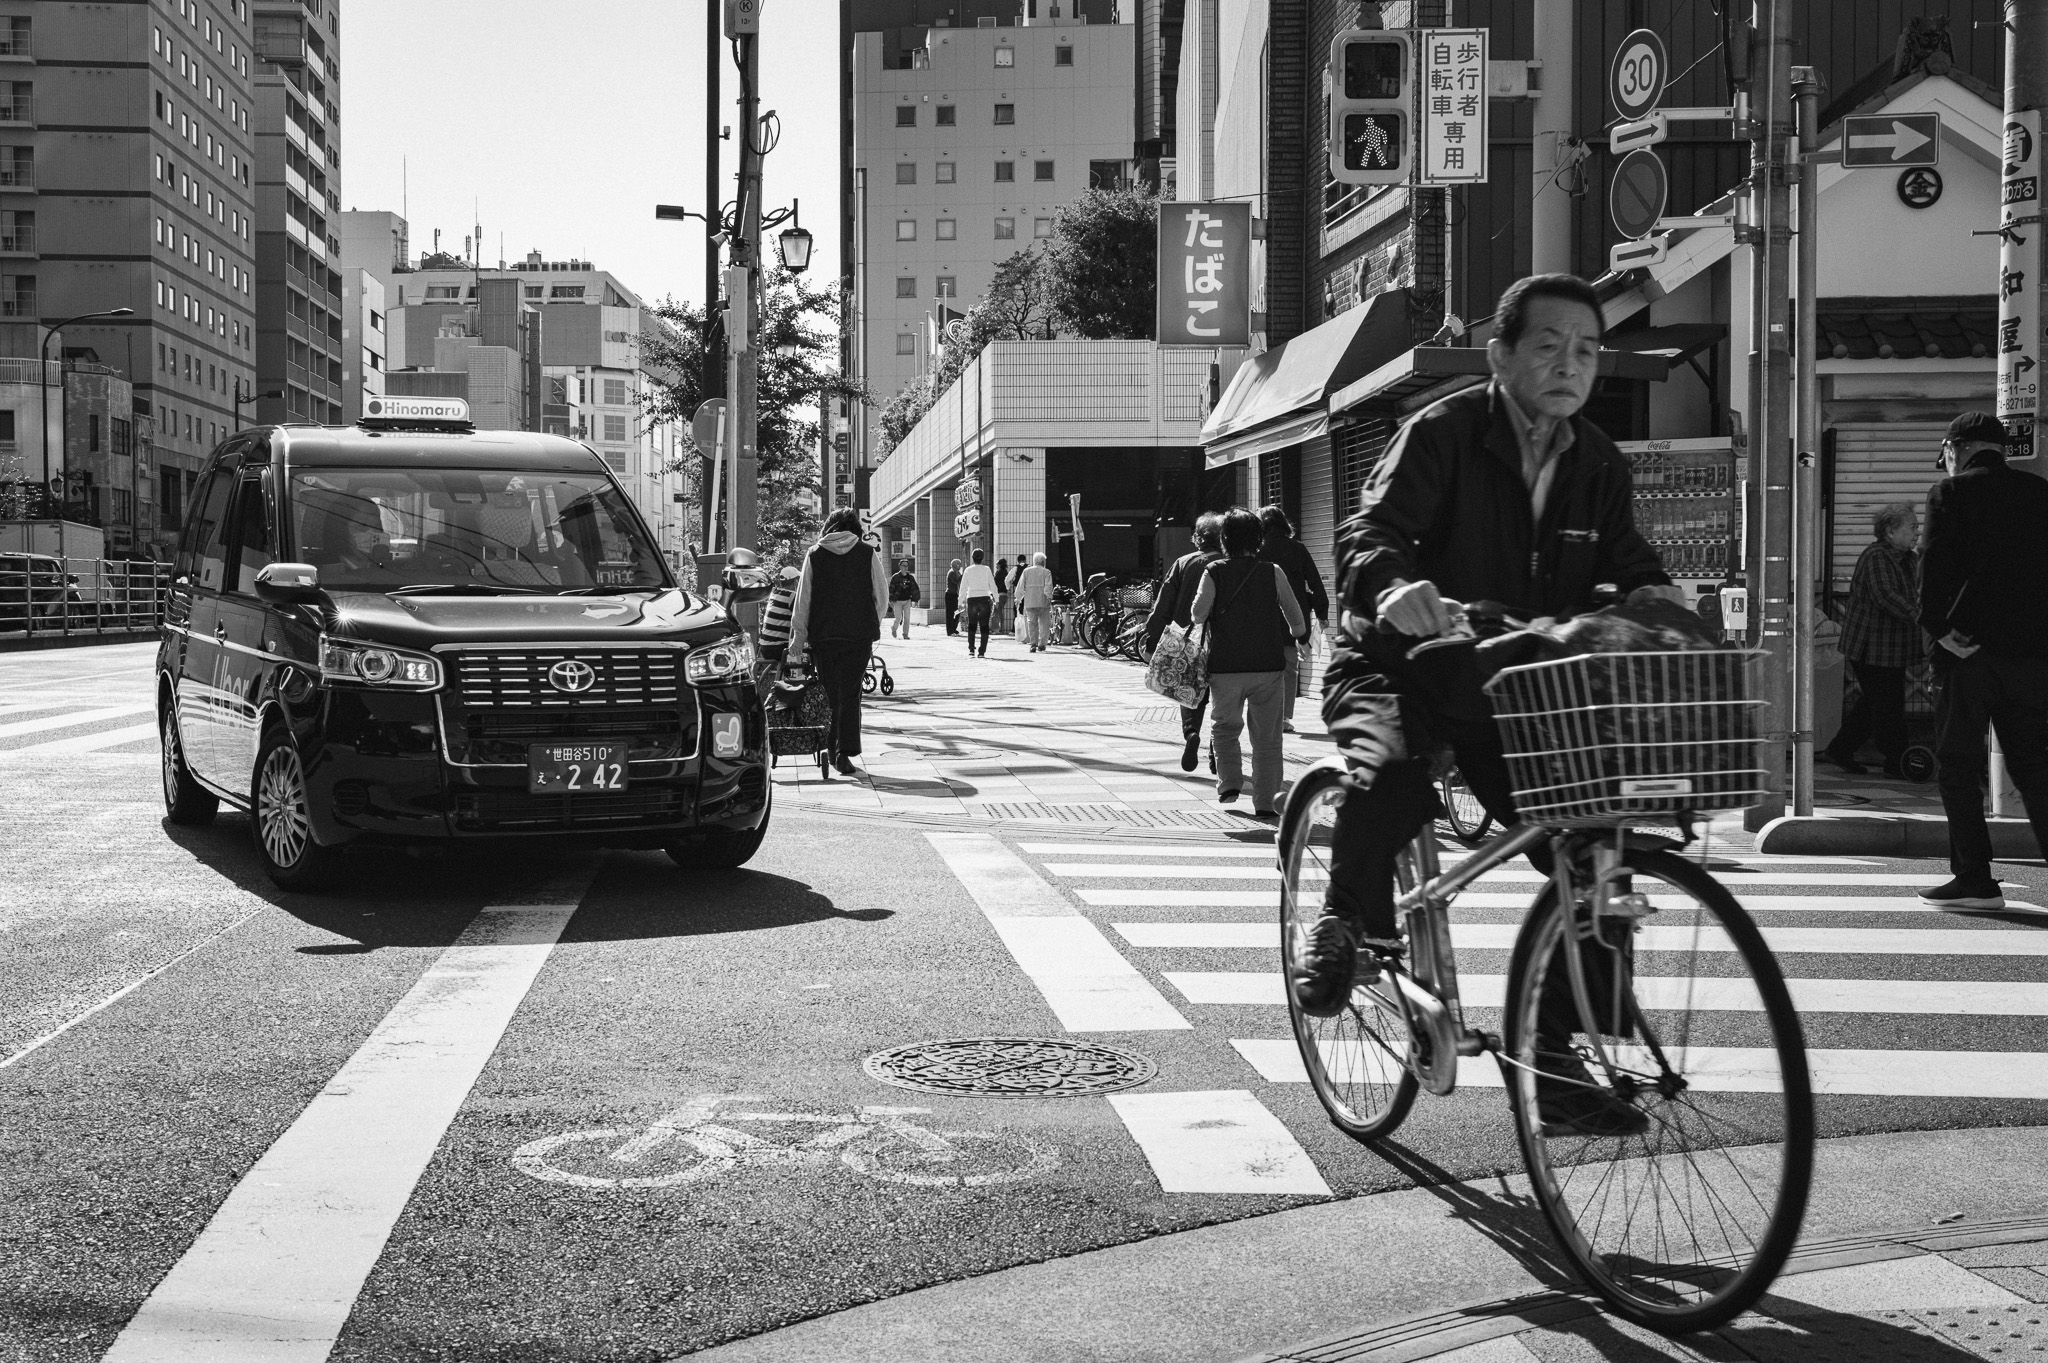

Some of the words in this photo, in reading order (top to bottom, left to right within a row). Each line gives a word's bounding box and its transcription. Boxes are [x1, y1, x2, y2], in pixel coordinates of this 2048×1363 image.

[1431, 42, 1453, 117] 自転車
[1457, 41, 1480, 116] 歩行者
[1623, 53, 1653, 96] 30
[1443, 121, 1466, 170] 専用
[1184, 208, 1225, 337] たばこ
[384, 401, 461, 416] Hinomaru
[537, 771, 547, 785] え
